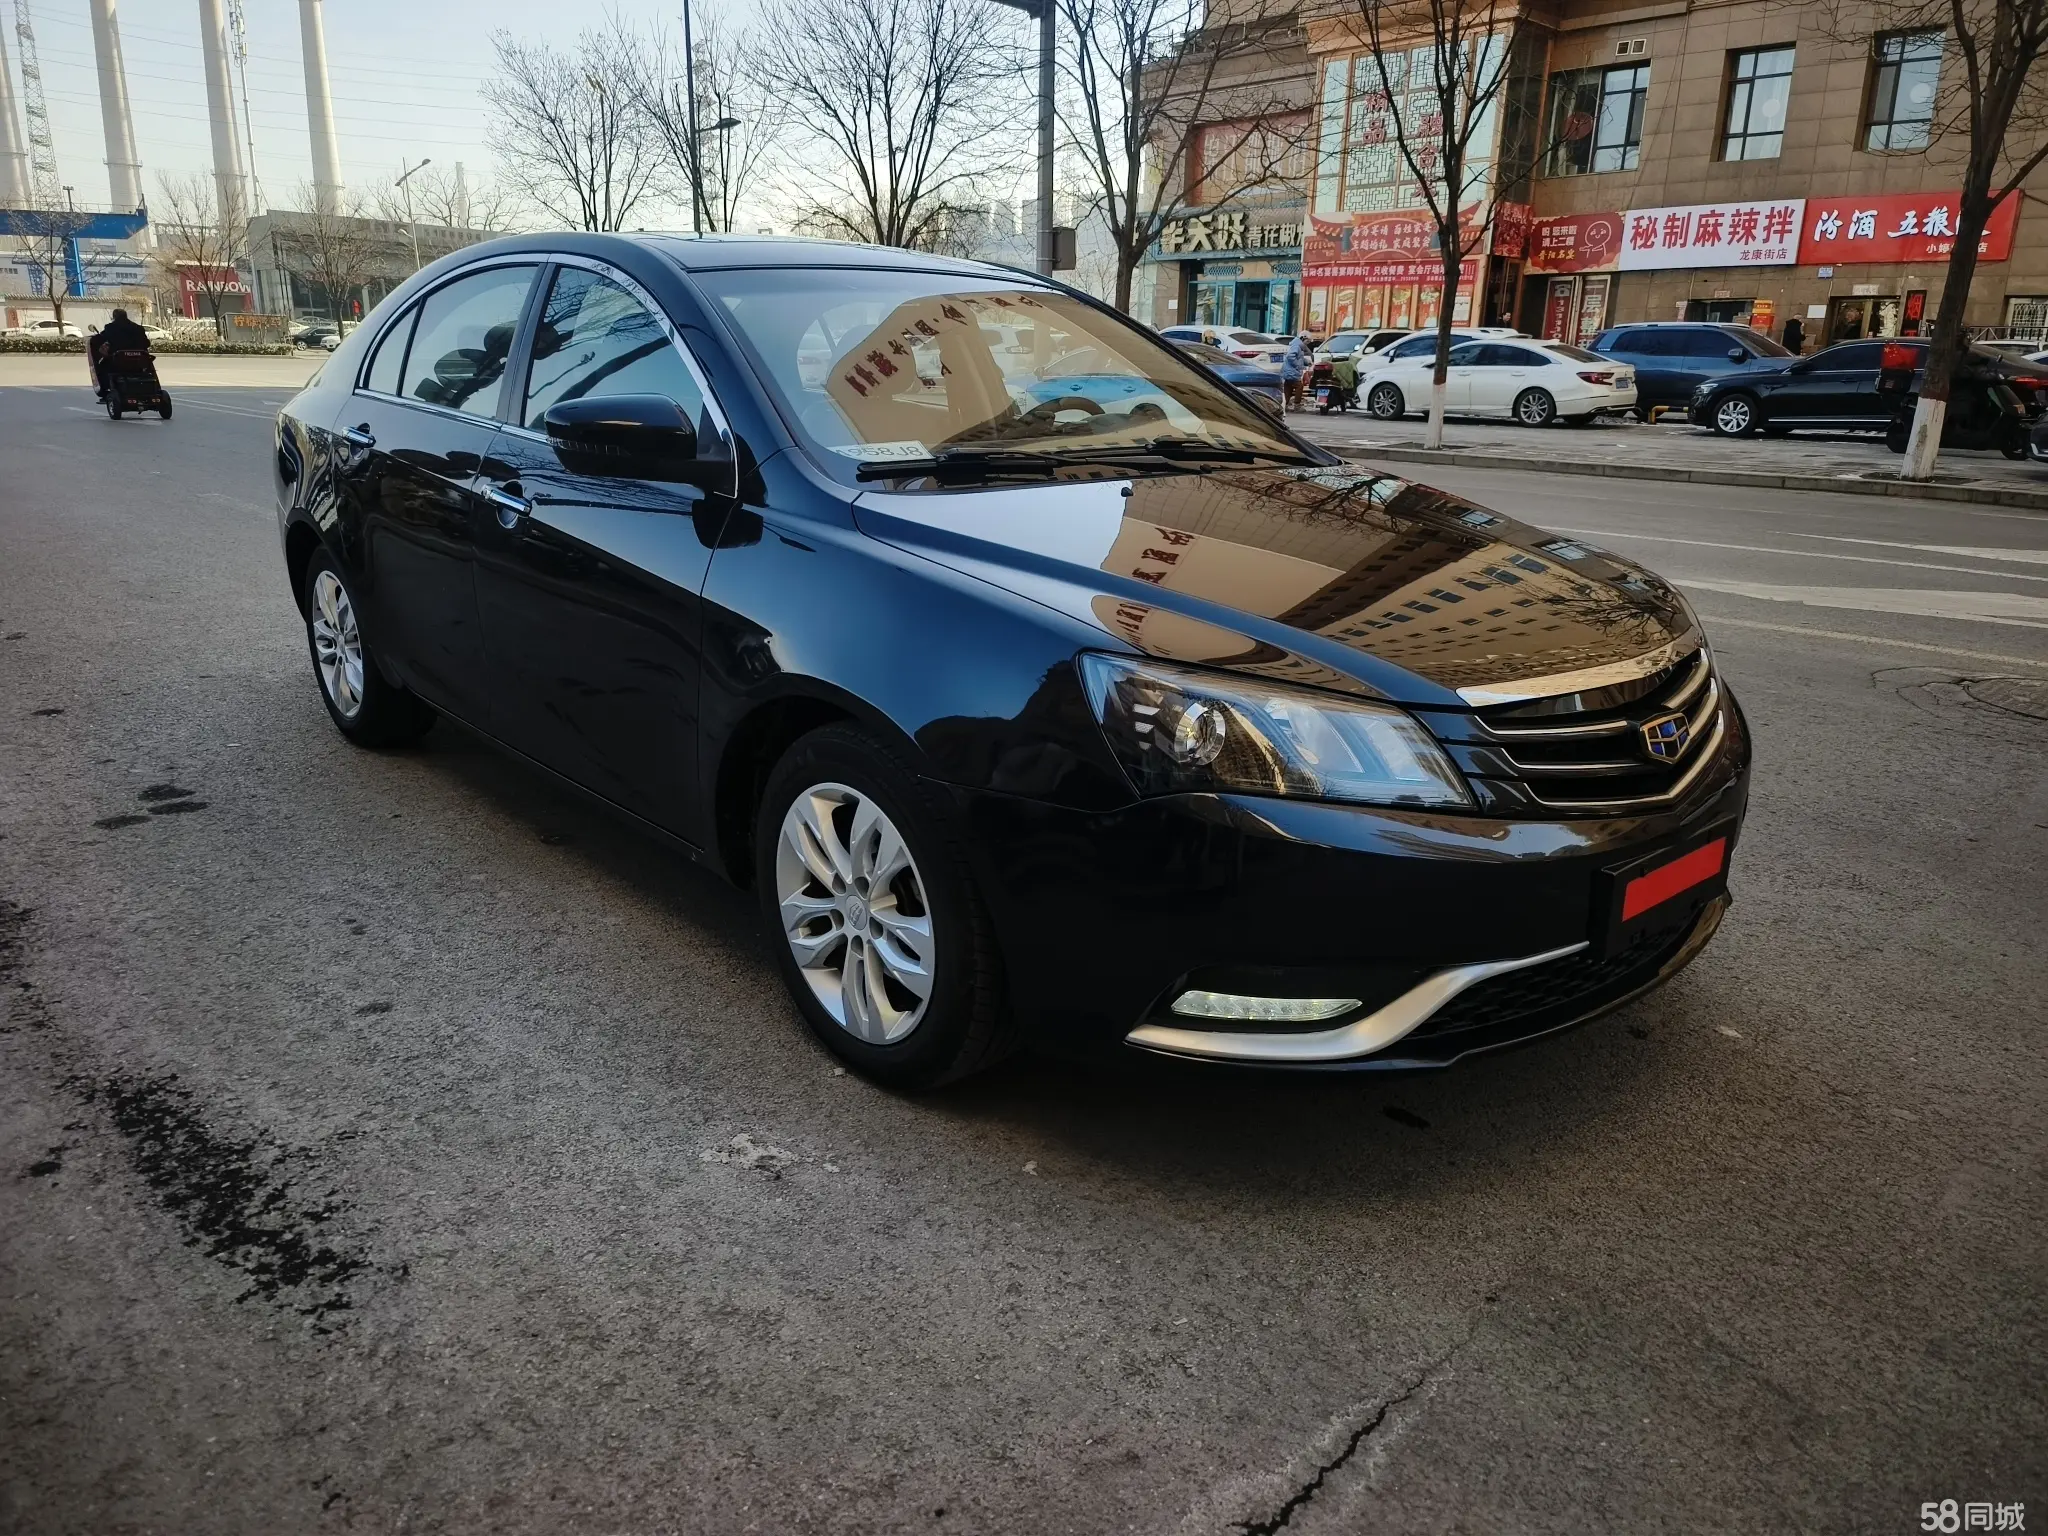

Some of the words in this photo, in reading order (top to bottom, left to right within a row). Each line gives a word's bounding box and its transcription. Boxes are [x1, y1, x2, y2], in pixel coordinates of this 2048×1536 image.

[1629, 205, 1796, 251] 秘制麻辣拌
[1813, 208, 1879, 242] 汾酒
[1887, 205, 1991, 238] 五粮
[1739, 248, 1788, 261] 龙康街店
[1926, 242, 1988, 254] 小婷店
